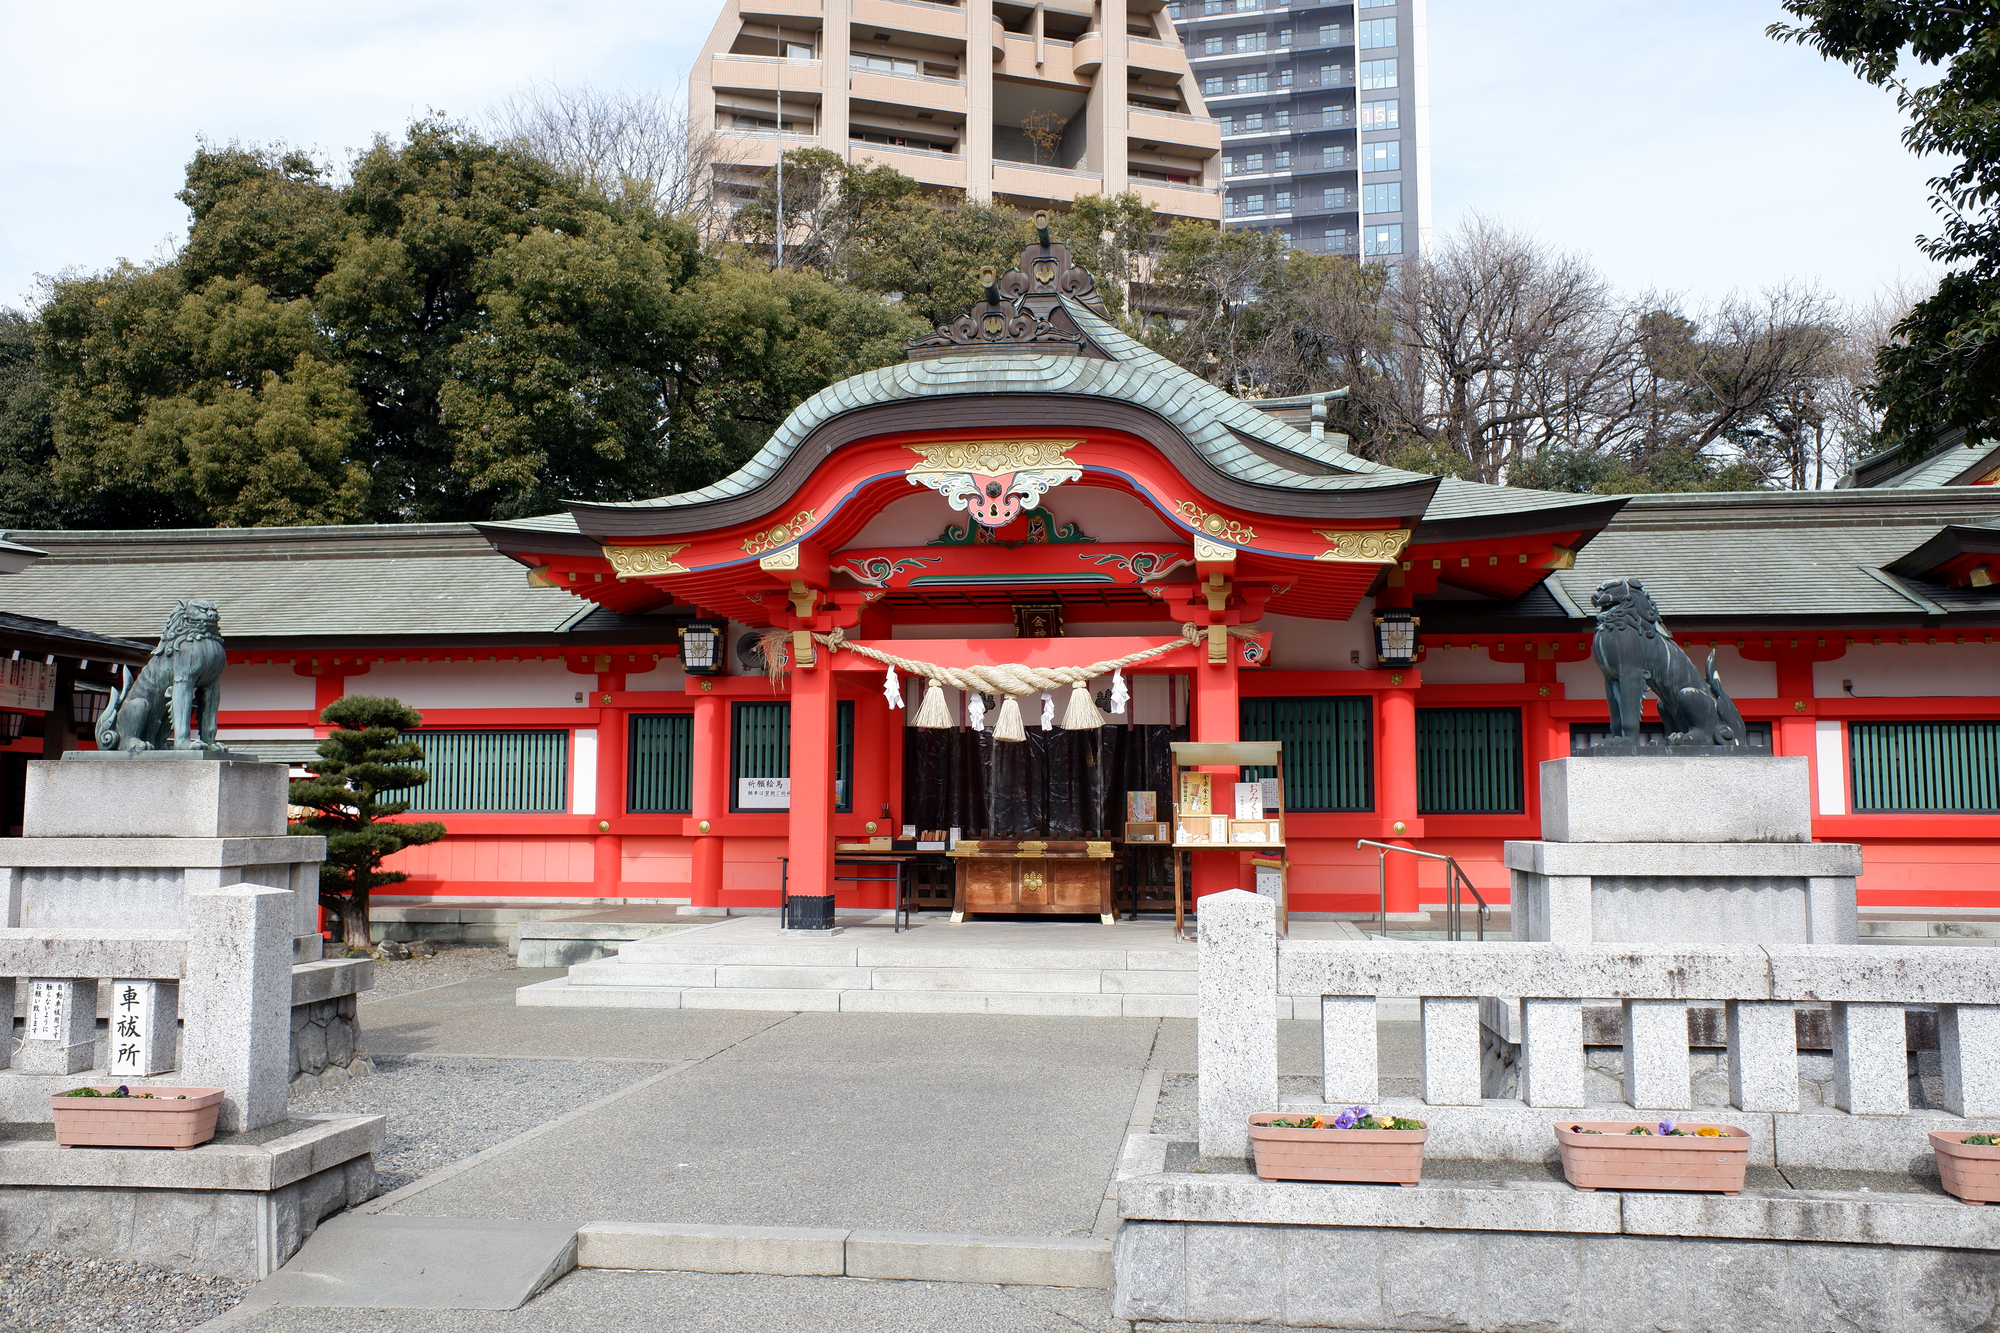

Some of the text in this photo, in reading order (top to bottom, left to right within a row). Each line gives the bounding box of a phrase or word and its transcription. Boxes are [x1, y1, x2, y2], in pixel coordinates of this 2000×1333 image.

[1249, 784, 1260, 819] おみくじ
[32, 983, 42, 1035] お願い致します
[42, 983, 53, 1032] 触らないように
[53, 983, 64, 1039] 自動車祓用です
[116, 985, 142, 1067] 車祓所
